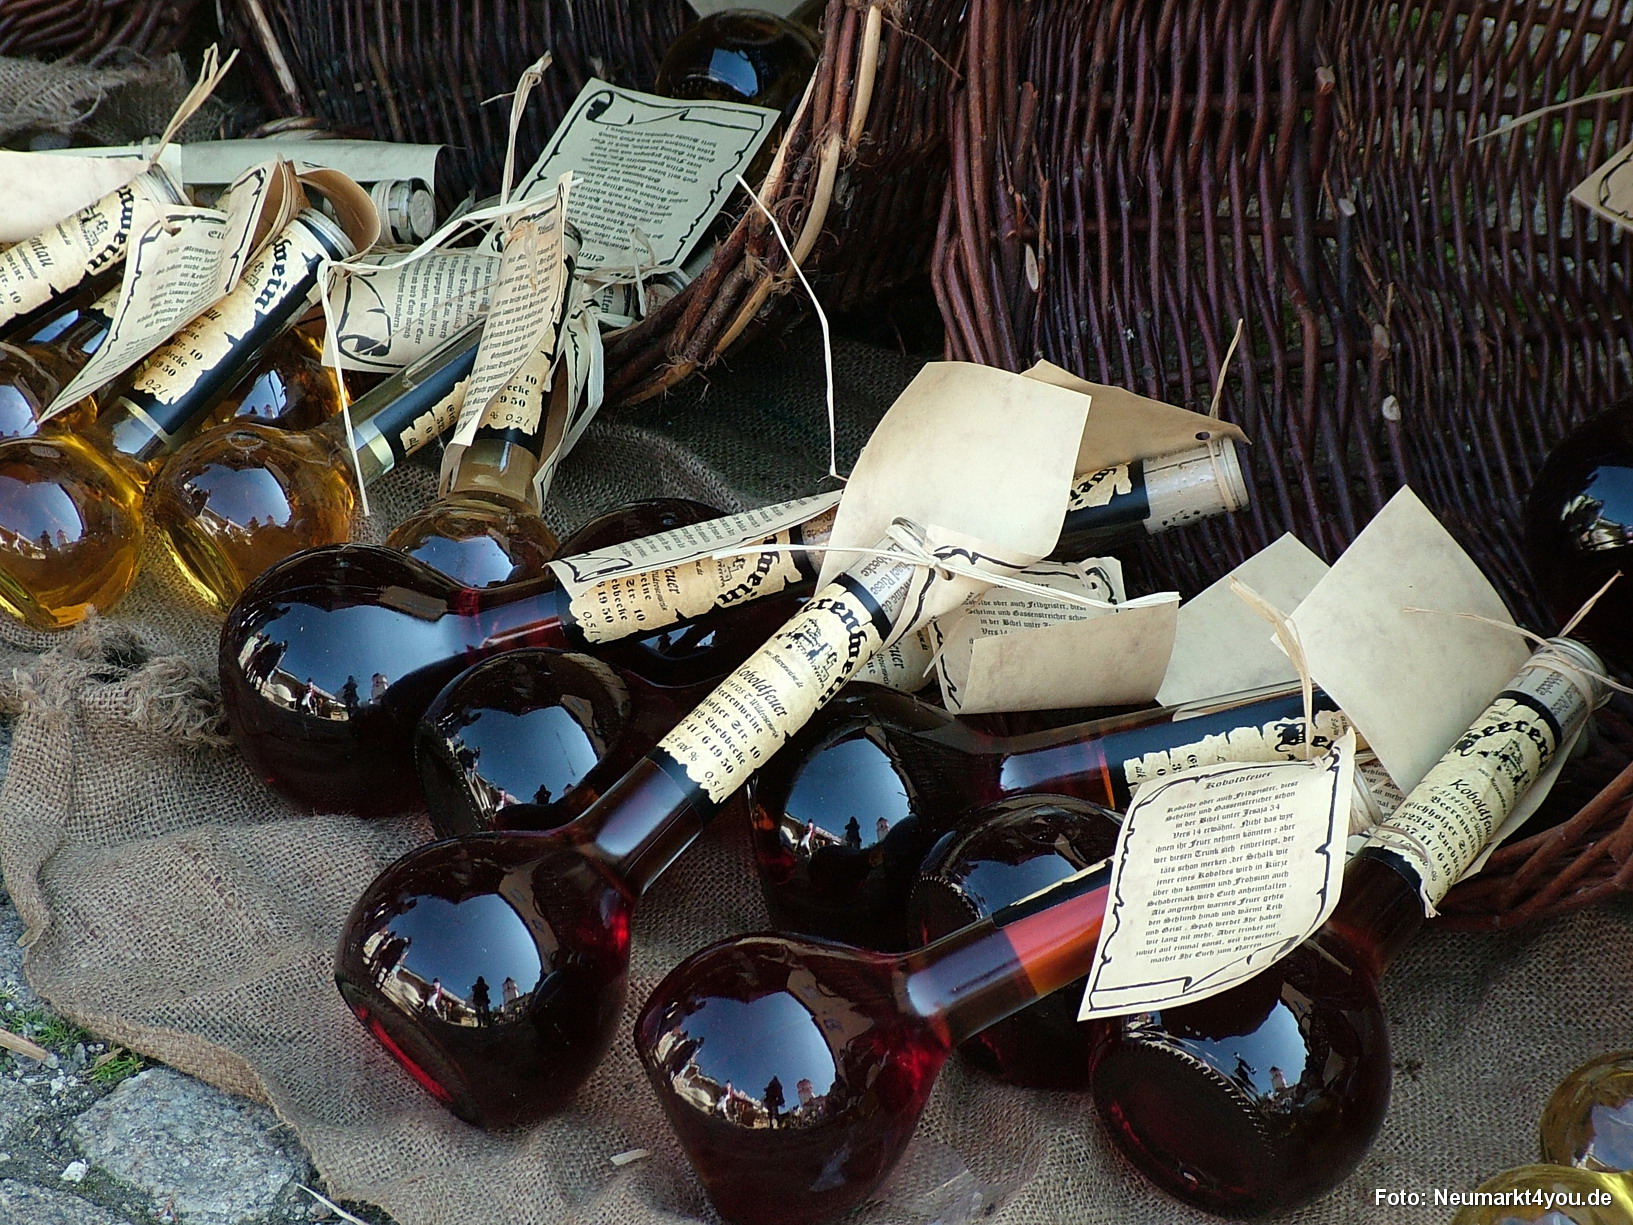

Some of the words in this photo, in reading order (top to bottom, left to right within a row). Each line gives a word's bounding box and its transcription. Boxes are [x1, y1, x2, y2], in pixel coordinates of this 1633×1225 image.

[189, 348, 202, 360] 10
[161, 364, 176, 376] 50
[525, 374, 537, 385] 10
[510, 396, 525, 407] 50
[597, 590, 607, 603] 19
[625, 577, 635, 603] Str.
[633, 609, 645, 621] 10
[601, 607, 614, 623] 50
[704, 716, 745, 765] Luebbecke
[730, 719, 747, 743] Str.
[749, 745, 760, 758] 10
[701, 735, 710, 744] 6
[709, 744, 722, 757] 19
[720, 757, 733, 773] 50
[1204, 771, 1272, 789] Koboldfeuer
[1269, 803, 1280, 811] 34
